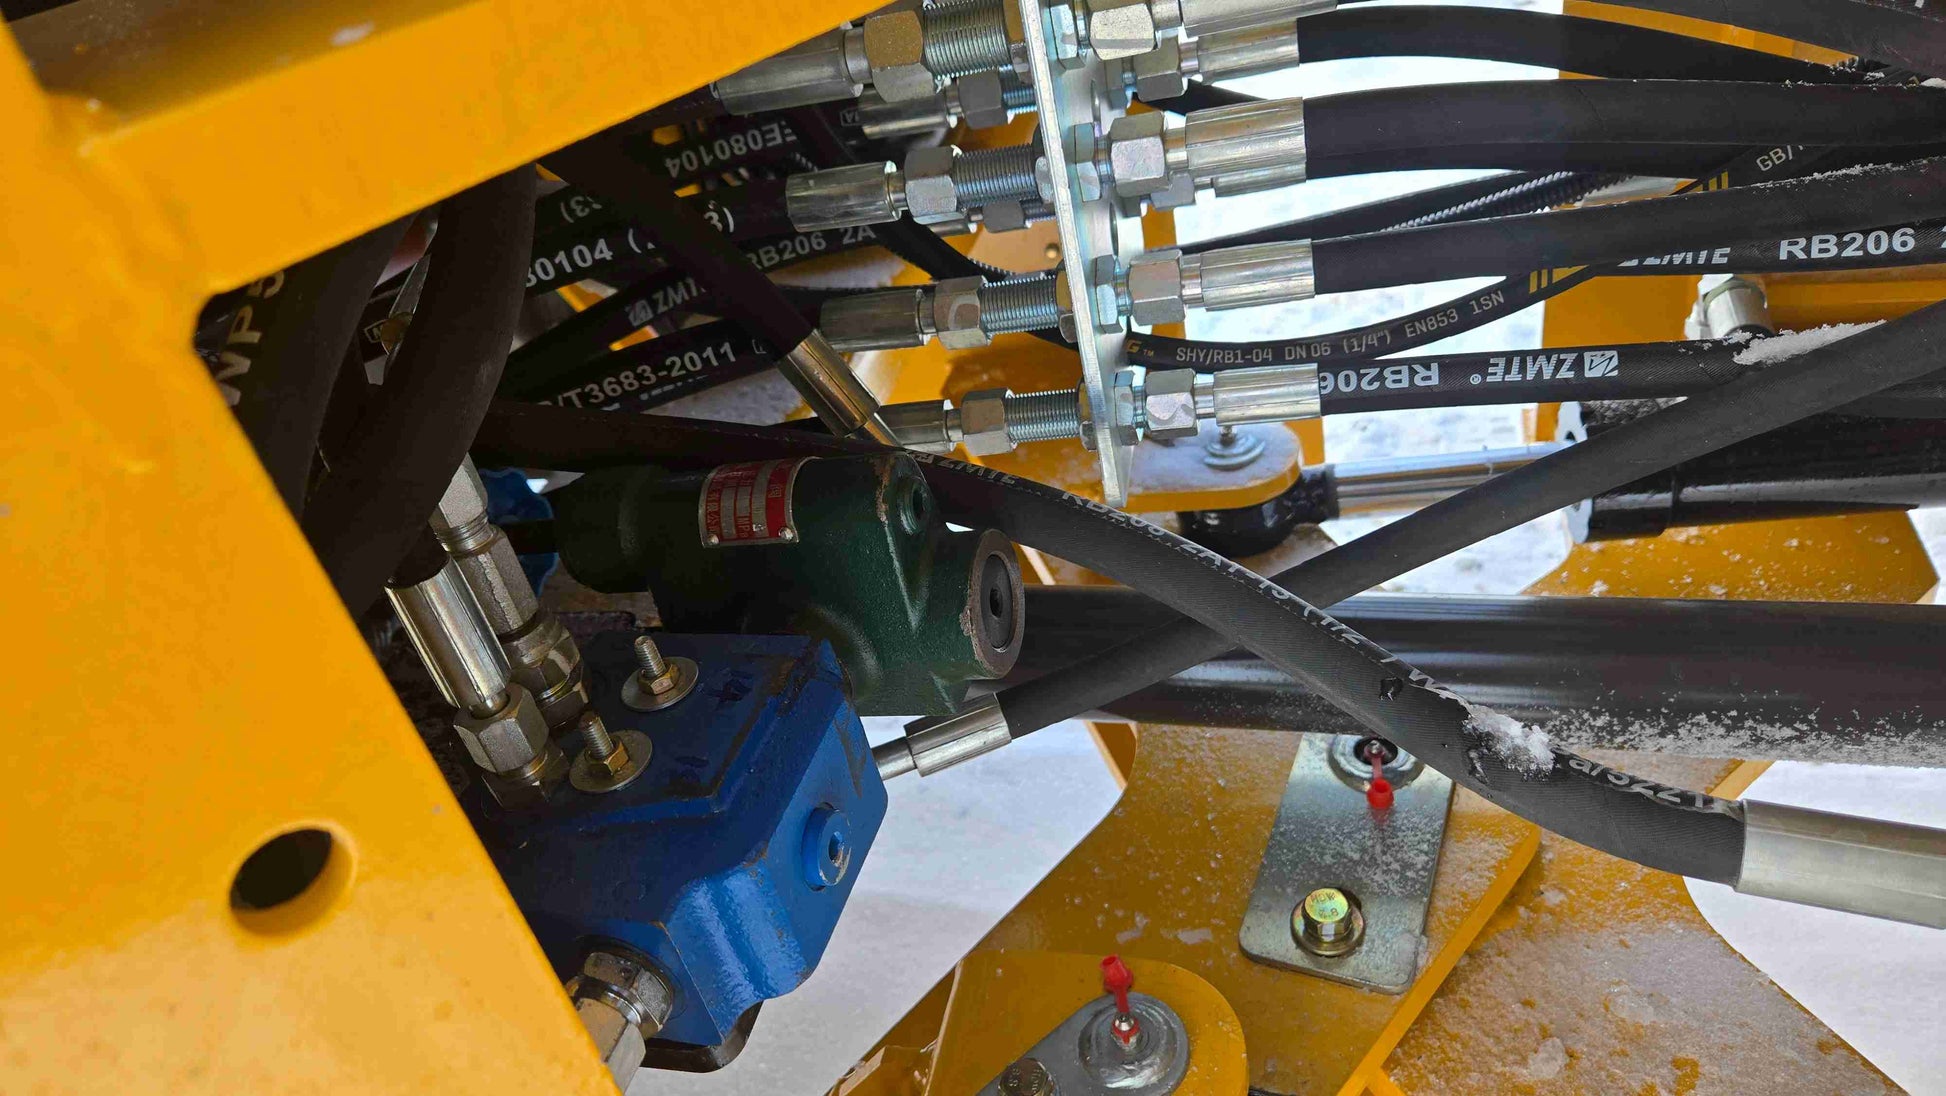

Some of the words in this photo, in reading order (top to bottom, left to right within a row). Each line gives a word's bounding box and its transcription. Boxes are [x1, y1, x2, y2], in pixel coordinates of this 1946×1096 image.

[1755, 144, 1804, 172] GB/
[1778, 227, 1917, 261] RB206
[1175, 346, 1274, 365] SHY/RB1-04
[1403, 308, 1460, 339] EN853
[1319, 361, 1440, 395] RB206
